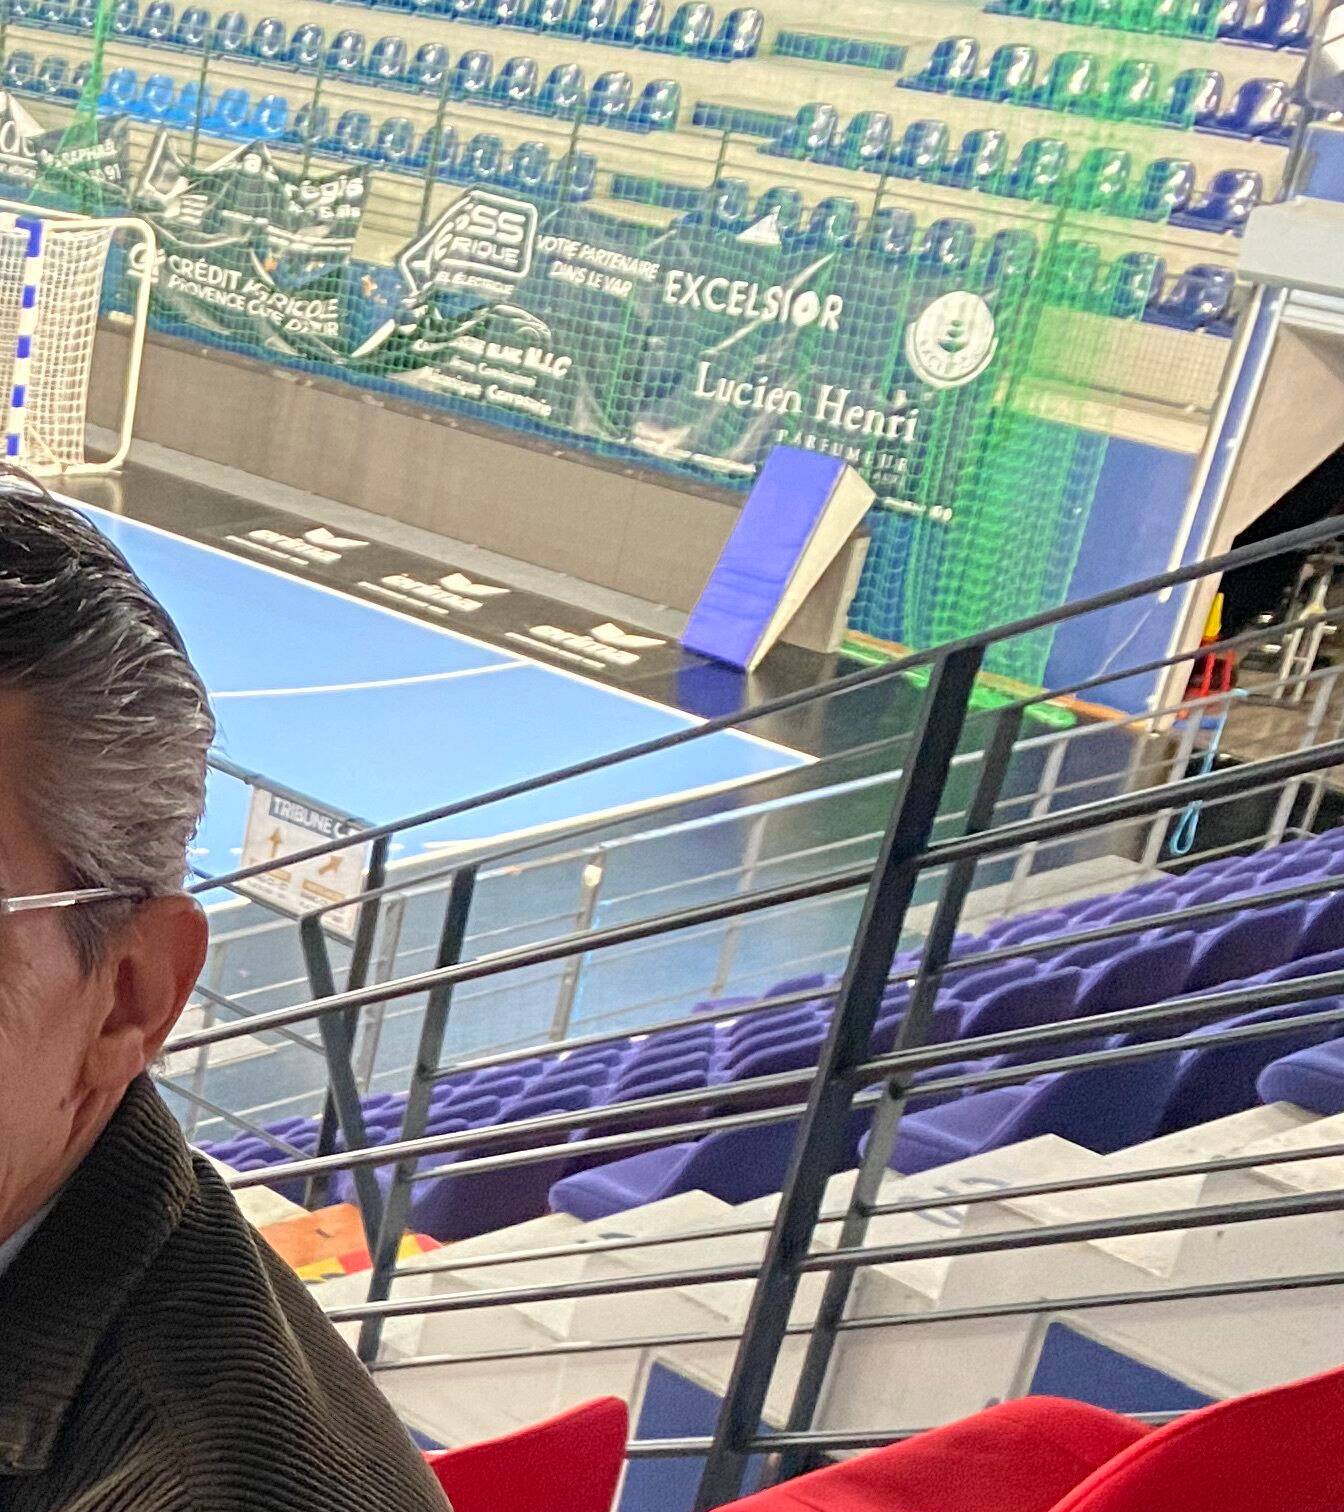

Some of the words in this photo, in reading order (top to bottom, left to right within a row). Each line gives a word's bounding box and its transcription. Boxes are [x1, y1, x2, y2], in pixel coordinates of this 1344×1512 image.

[665, 269, 844, 331] EXCELSIOR
[694, 360, 803, 414] Lucien
[815, 384, 920, 443] Henri
[273, 796, 334, 835] TRIBUNE
